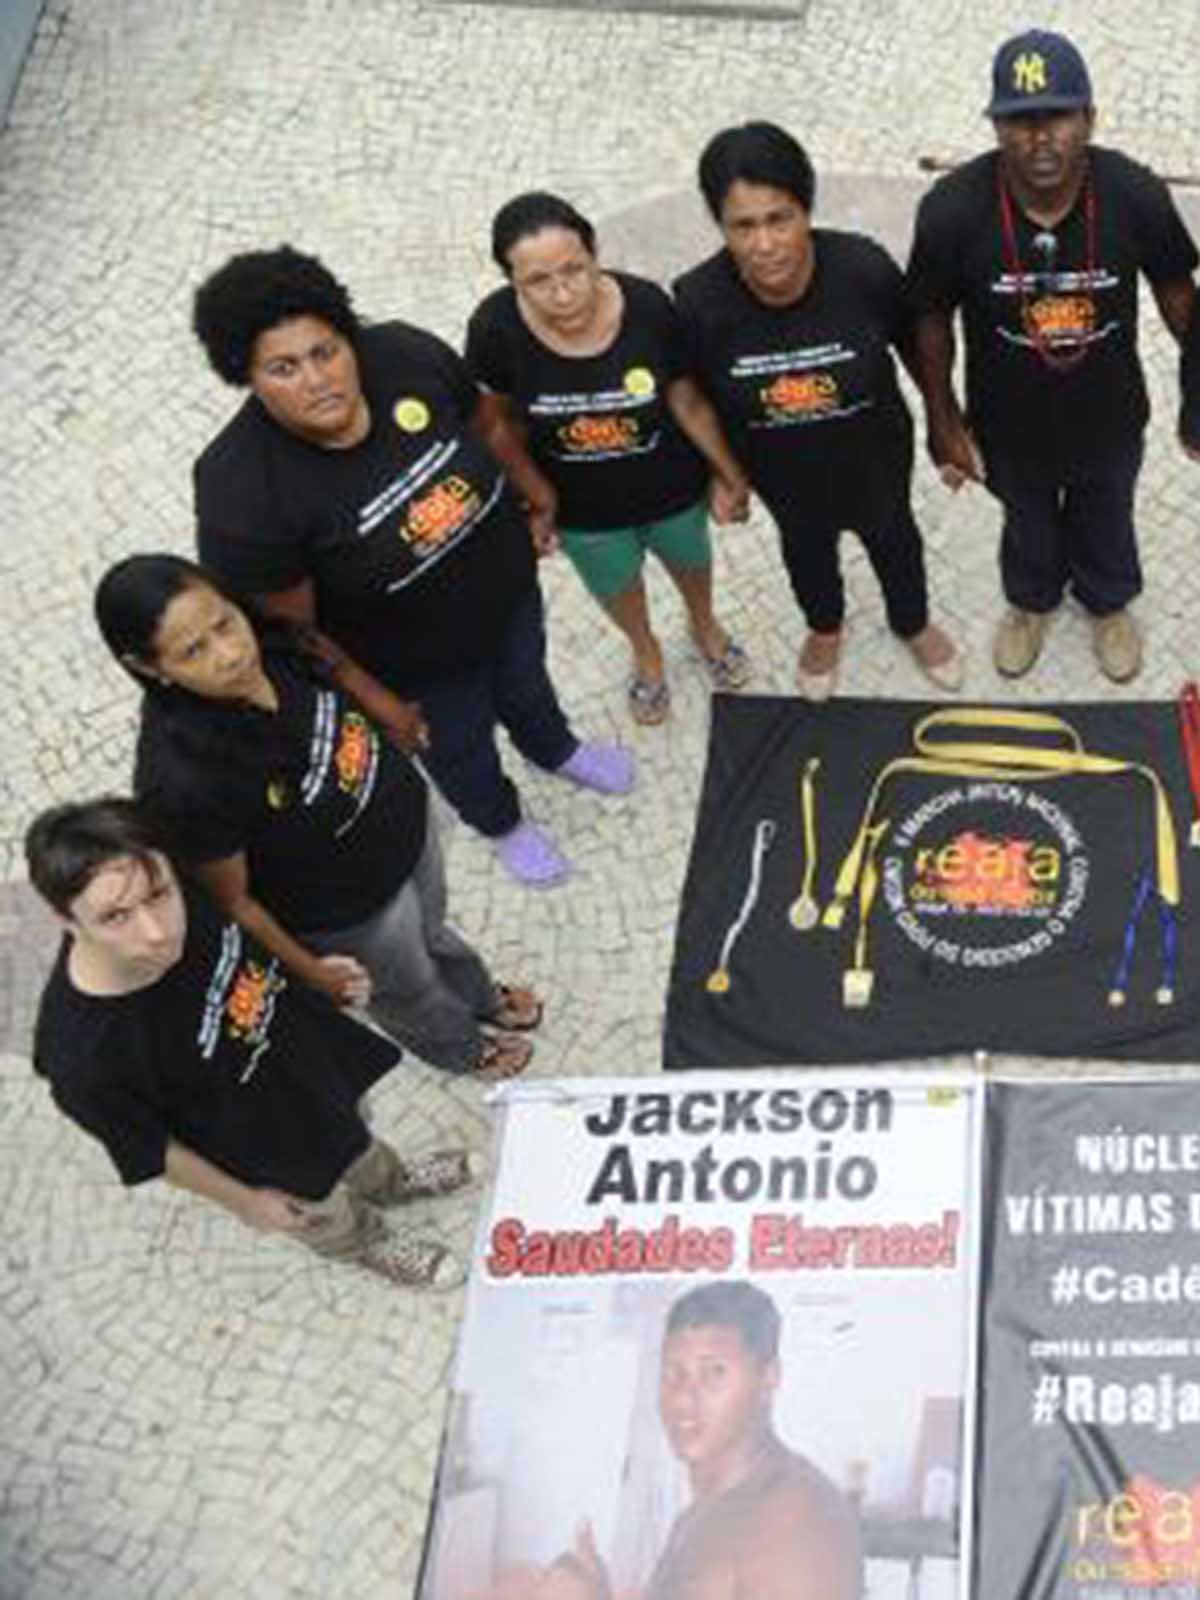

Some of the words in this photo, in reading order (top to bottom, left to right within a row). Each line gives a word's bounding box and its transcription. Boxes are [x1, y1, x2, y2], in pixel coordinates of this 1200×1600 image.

[585, 1088, 894, 1135] Jackson
[586, 1141, 878, 1204] Antonio
[1005, 1187, 1174, 1235] VÍTIMAS
[487, 1216, 734, 1278] Saudades
[747, 1210, 960, 1271] Eternas!
